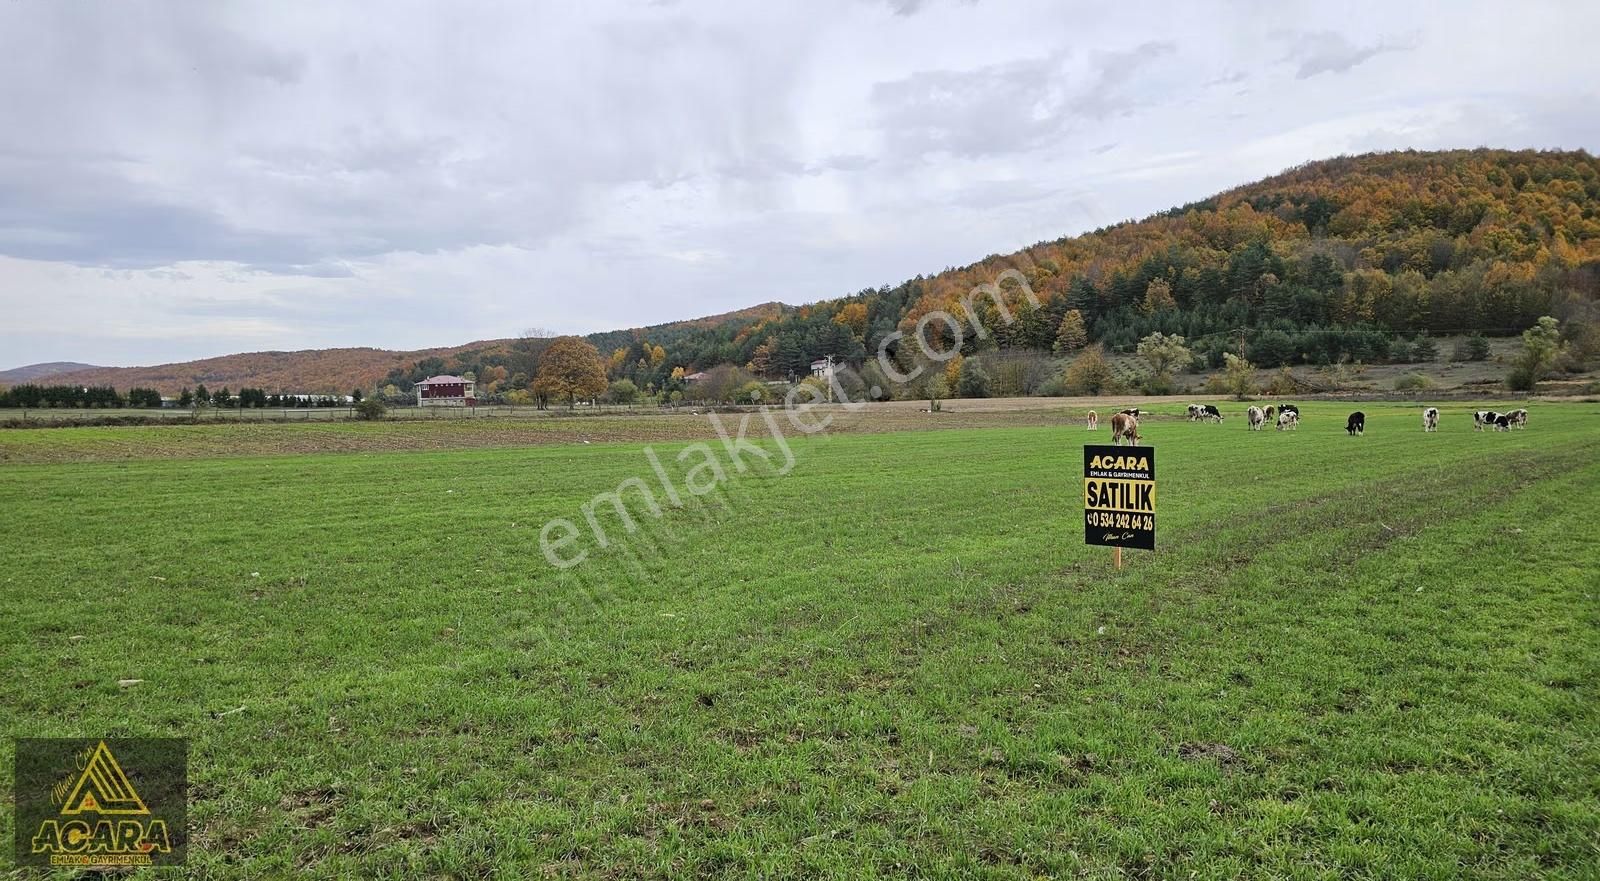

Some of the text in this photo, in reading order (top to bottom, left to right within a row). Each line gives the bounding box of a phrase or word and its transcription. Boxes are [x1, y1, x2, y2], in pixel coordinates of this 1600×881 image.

[1090, 455, 1149, 471] ACARA
[1087, 481, 1153, 511] SATILIK
[1092, 512, 1153, 531] 0 534 242 64 26
